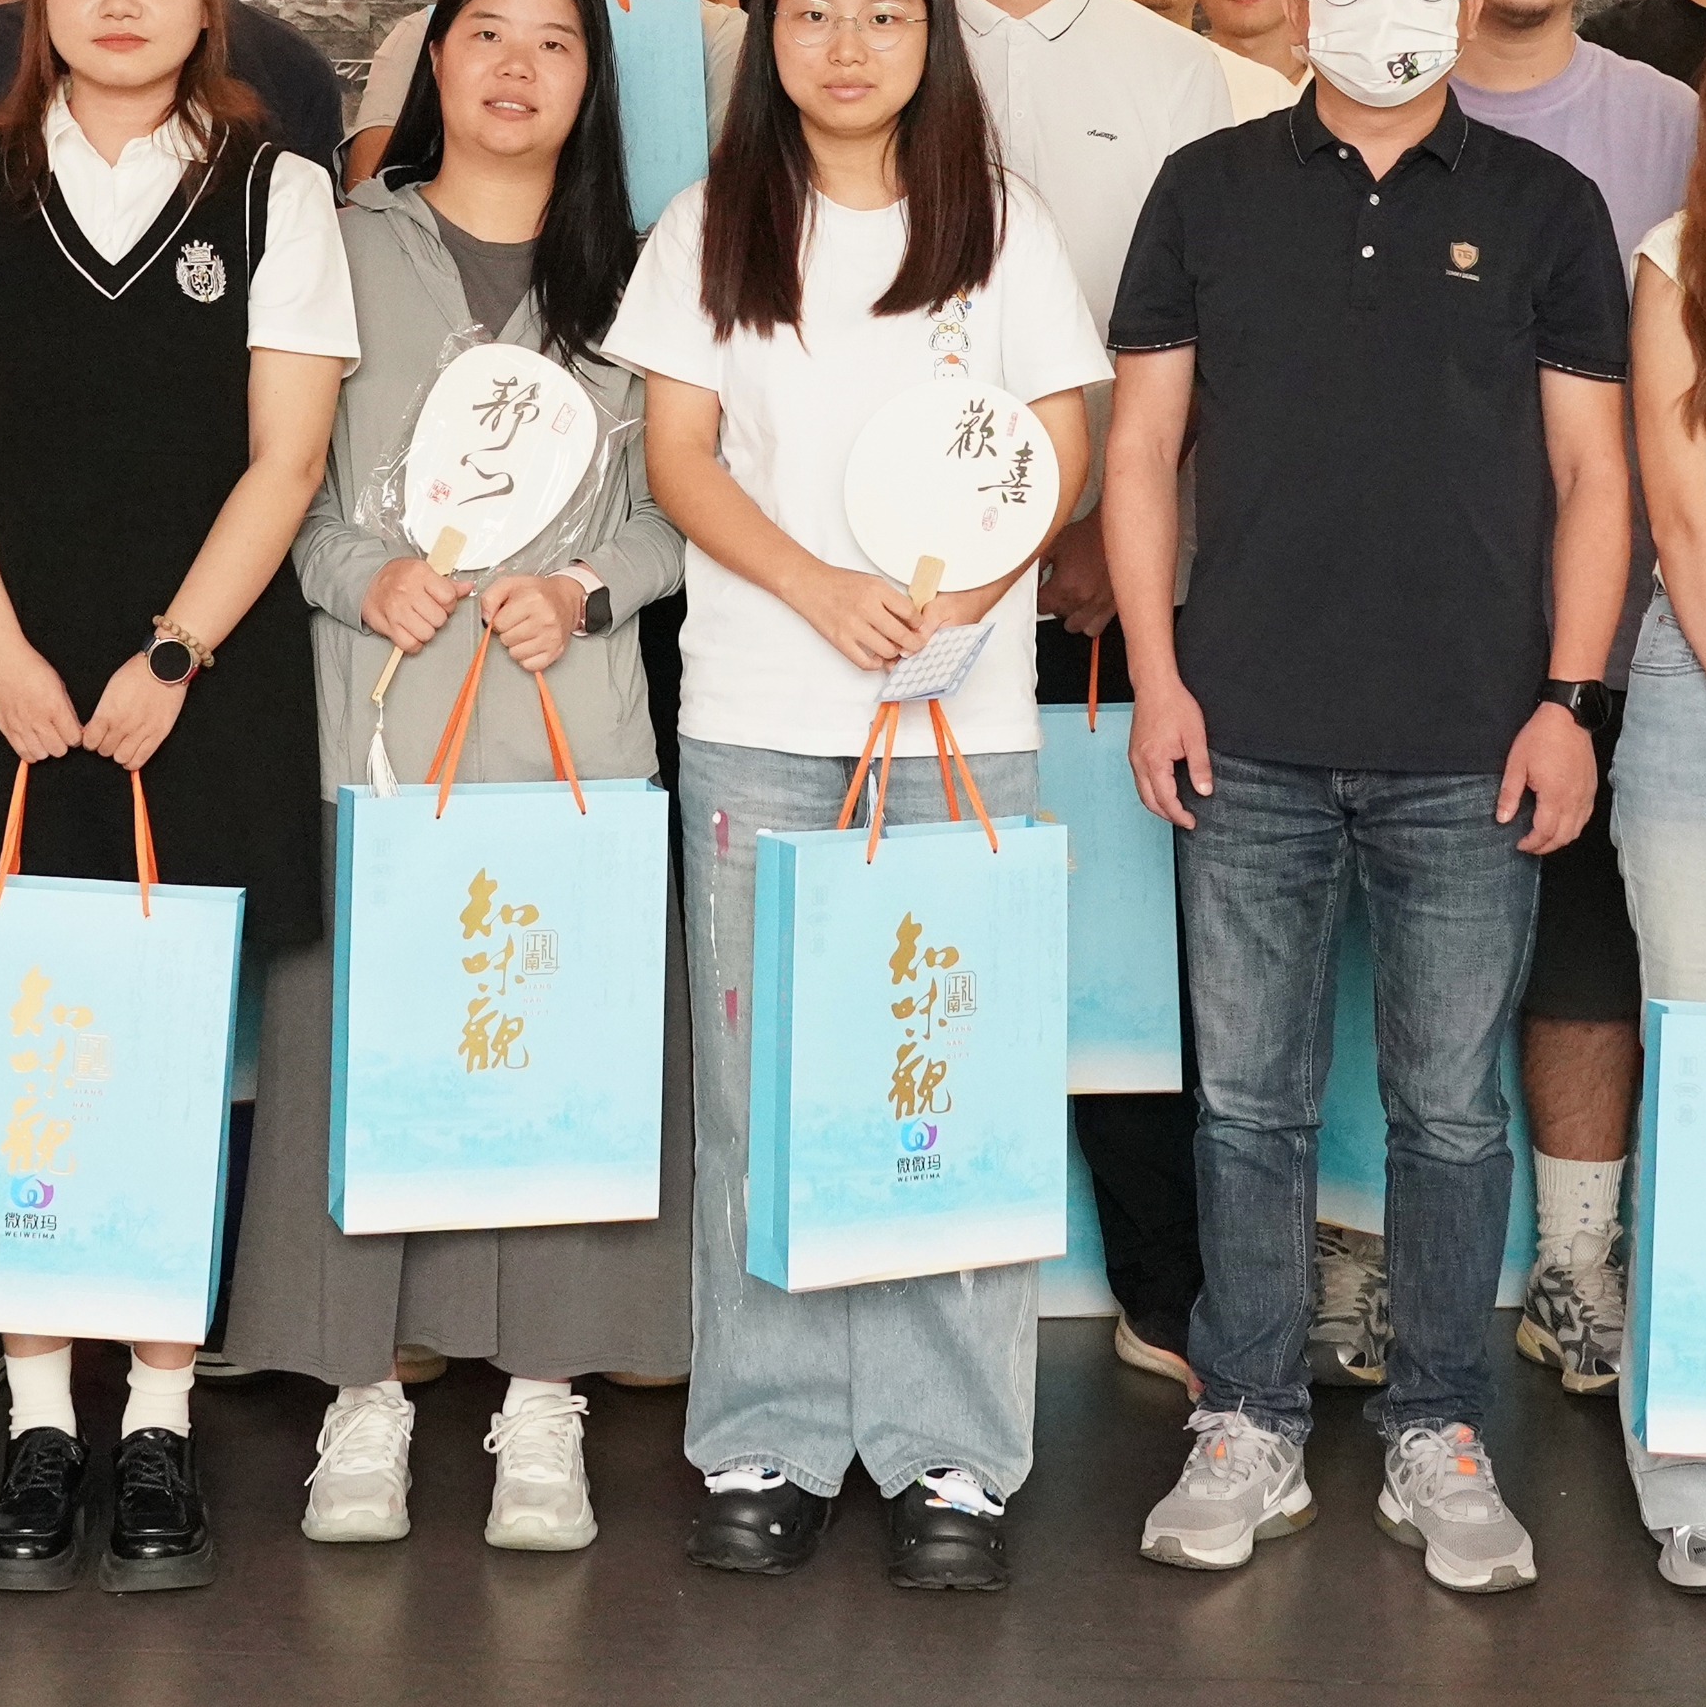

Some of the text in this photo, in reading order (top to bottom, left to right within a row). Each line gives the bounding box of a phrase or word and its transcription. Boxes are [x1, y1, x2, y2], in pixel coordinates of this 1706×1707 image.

[896, 1153, 941, 1174] 微微玛
[897, 1173, 941, 1182] WEIWEIMA
[4, 1212, 57, 1231] 微微玛
[4, 1231, 56, 1240] WEIWEIMA
